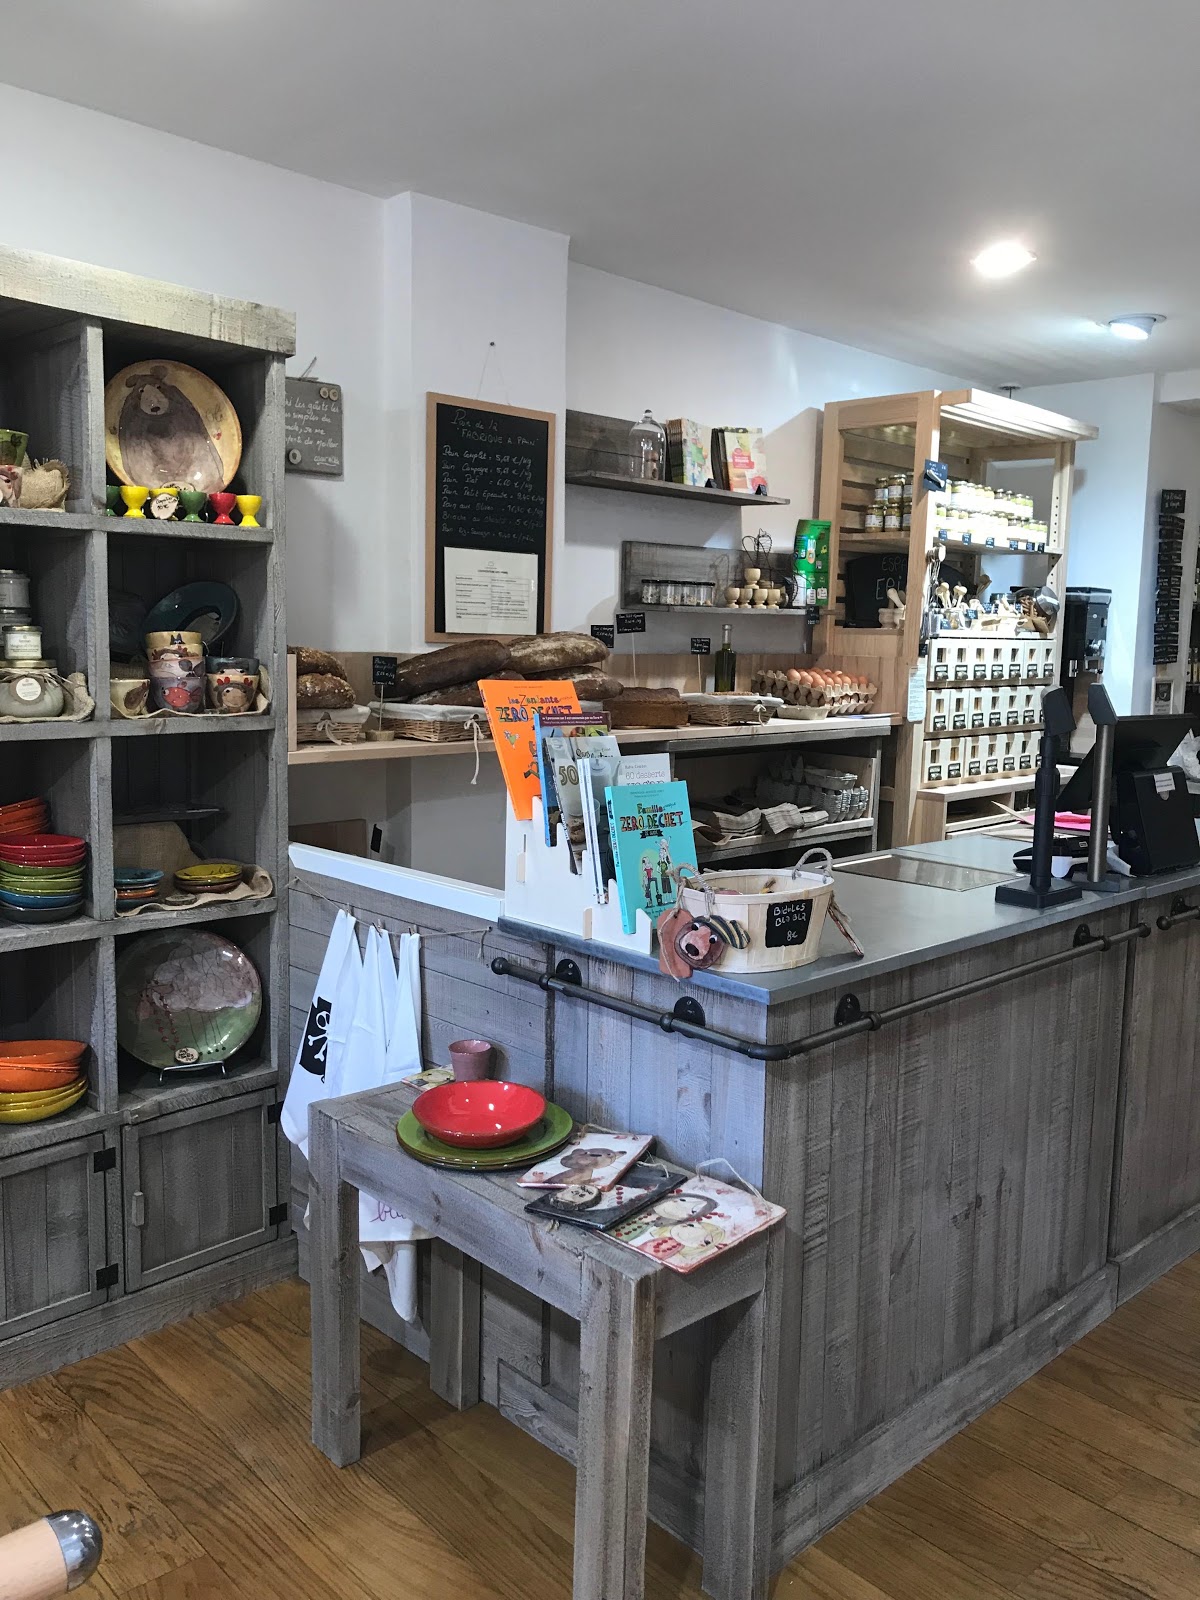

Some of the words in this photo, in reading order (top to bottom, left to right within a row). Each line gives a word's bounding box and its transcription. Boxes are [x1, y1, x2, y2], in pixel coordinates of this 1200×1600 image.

[495, 706, 529, 722] ZERO
[559, 765, 580, 786] 50
[620, 815, 645, 832] ZERO
[646, 811, 684, 830] DECHET
